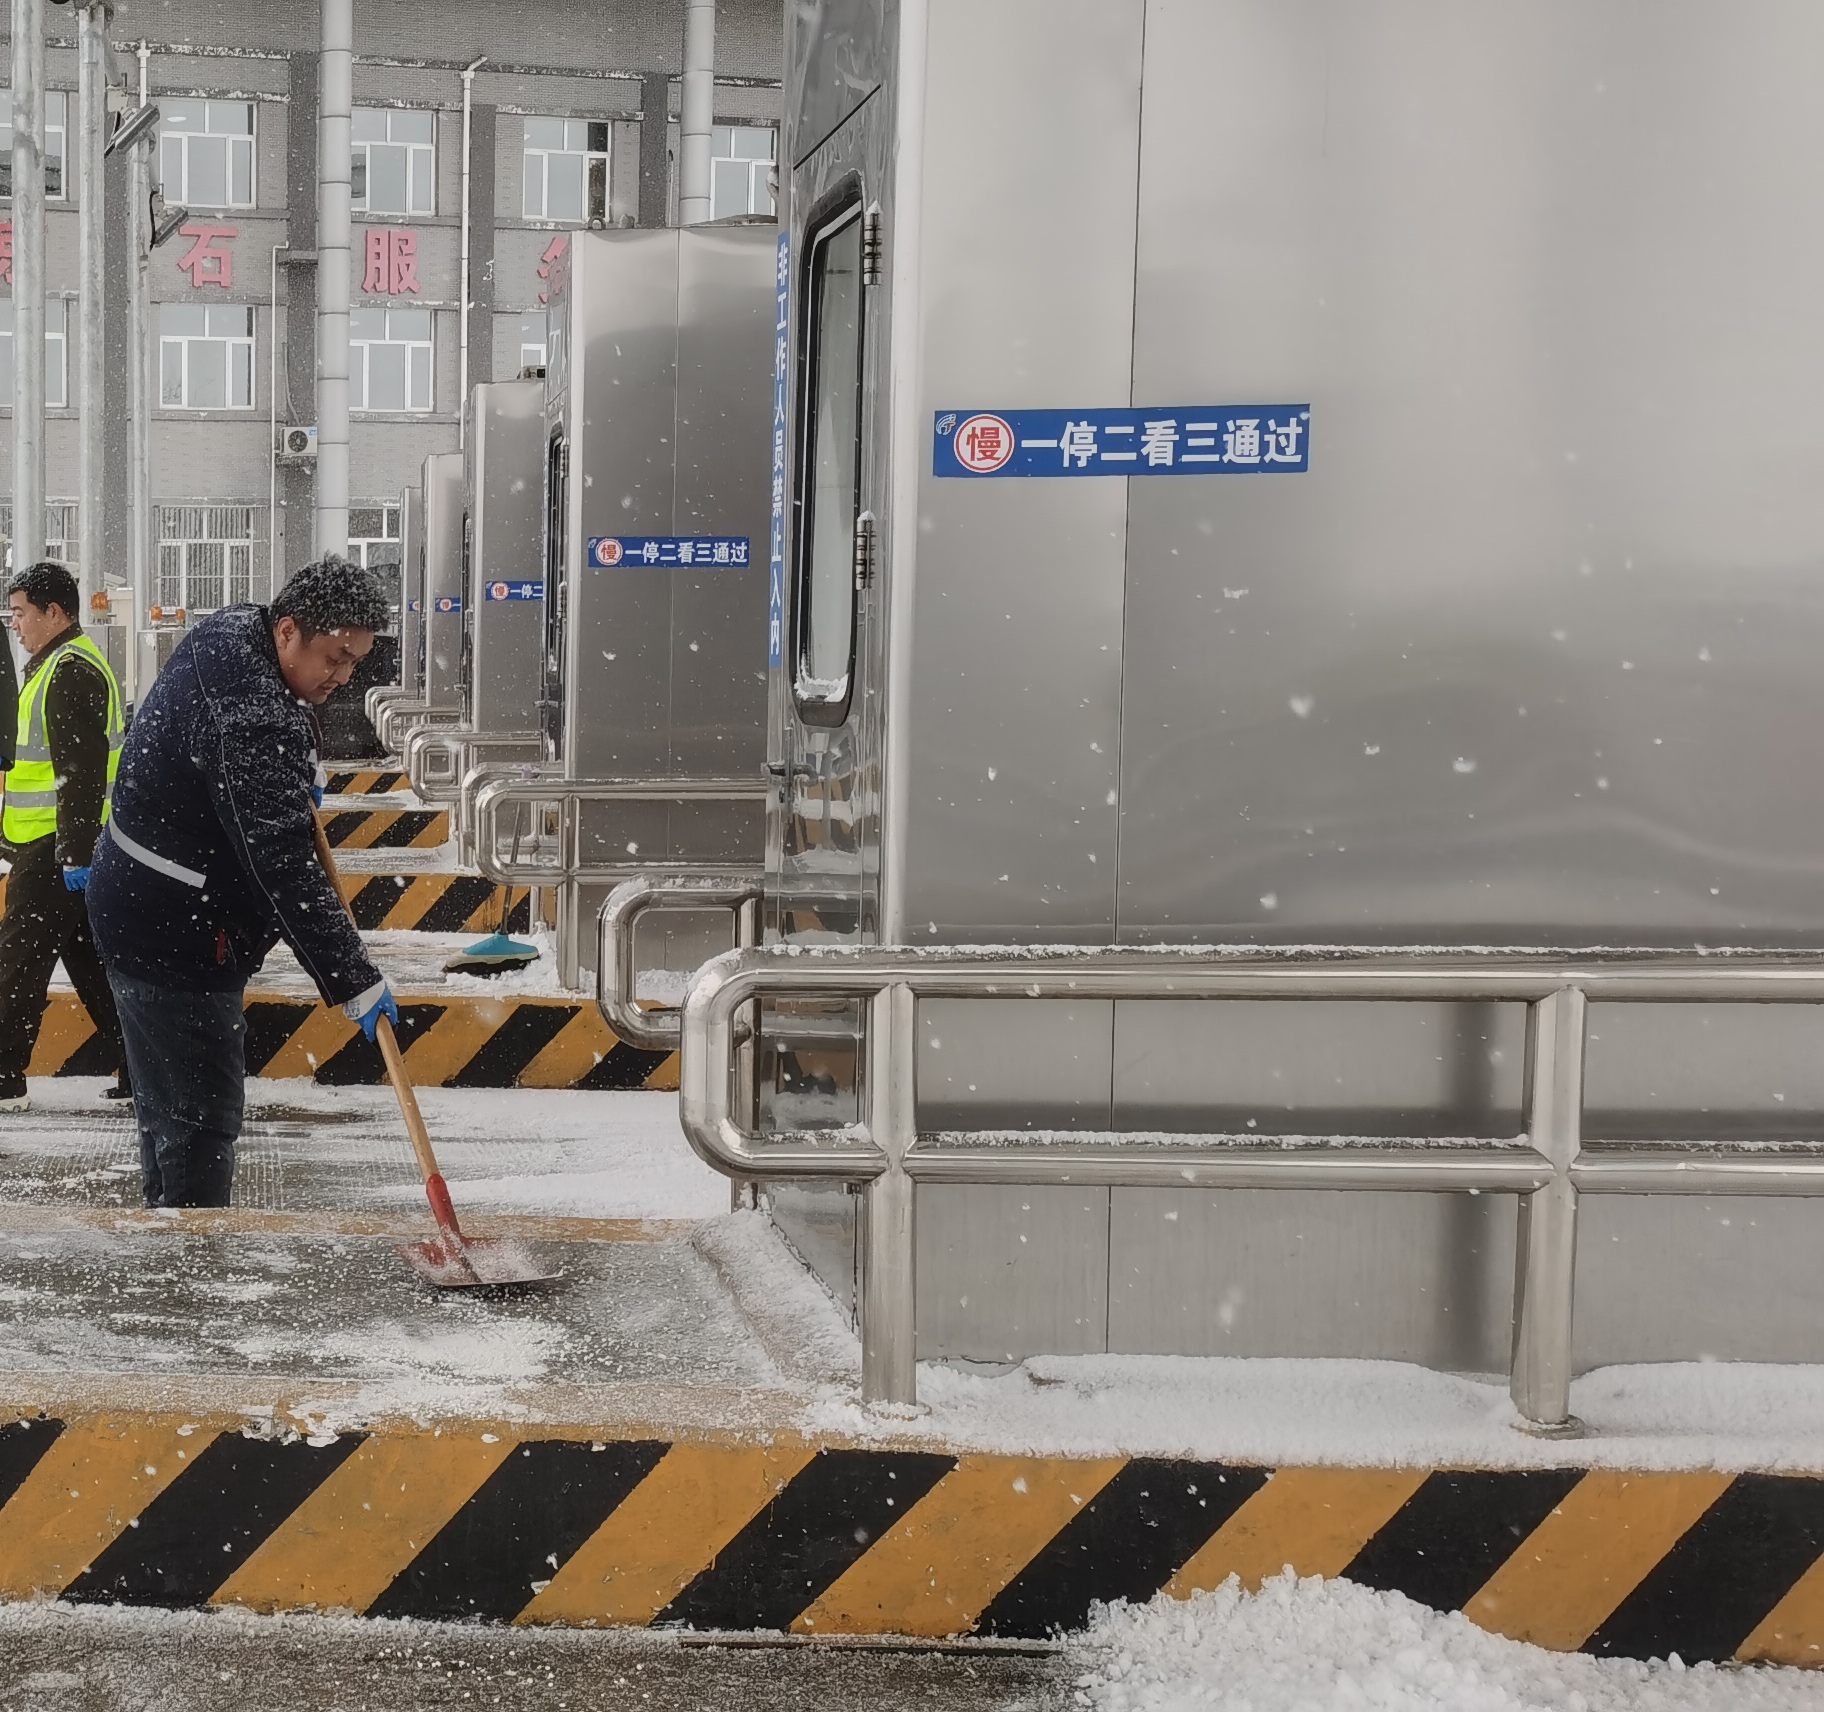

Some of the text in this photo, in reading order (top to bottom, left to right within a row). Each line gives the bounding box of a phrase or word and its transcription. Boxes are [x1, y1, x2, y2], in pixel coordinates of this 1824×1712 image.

[770, 242, 788, 656] 非工作人员禁止入内
[966, 419, 1303, 468] 慢 一停二看三通过
[601, 541, 747, 563] 慢 一停二看三通过
